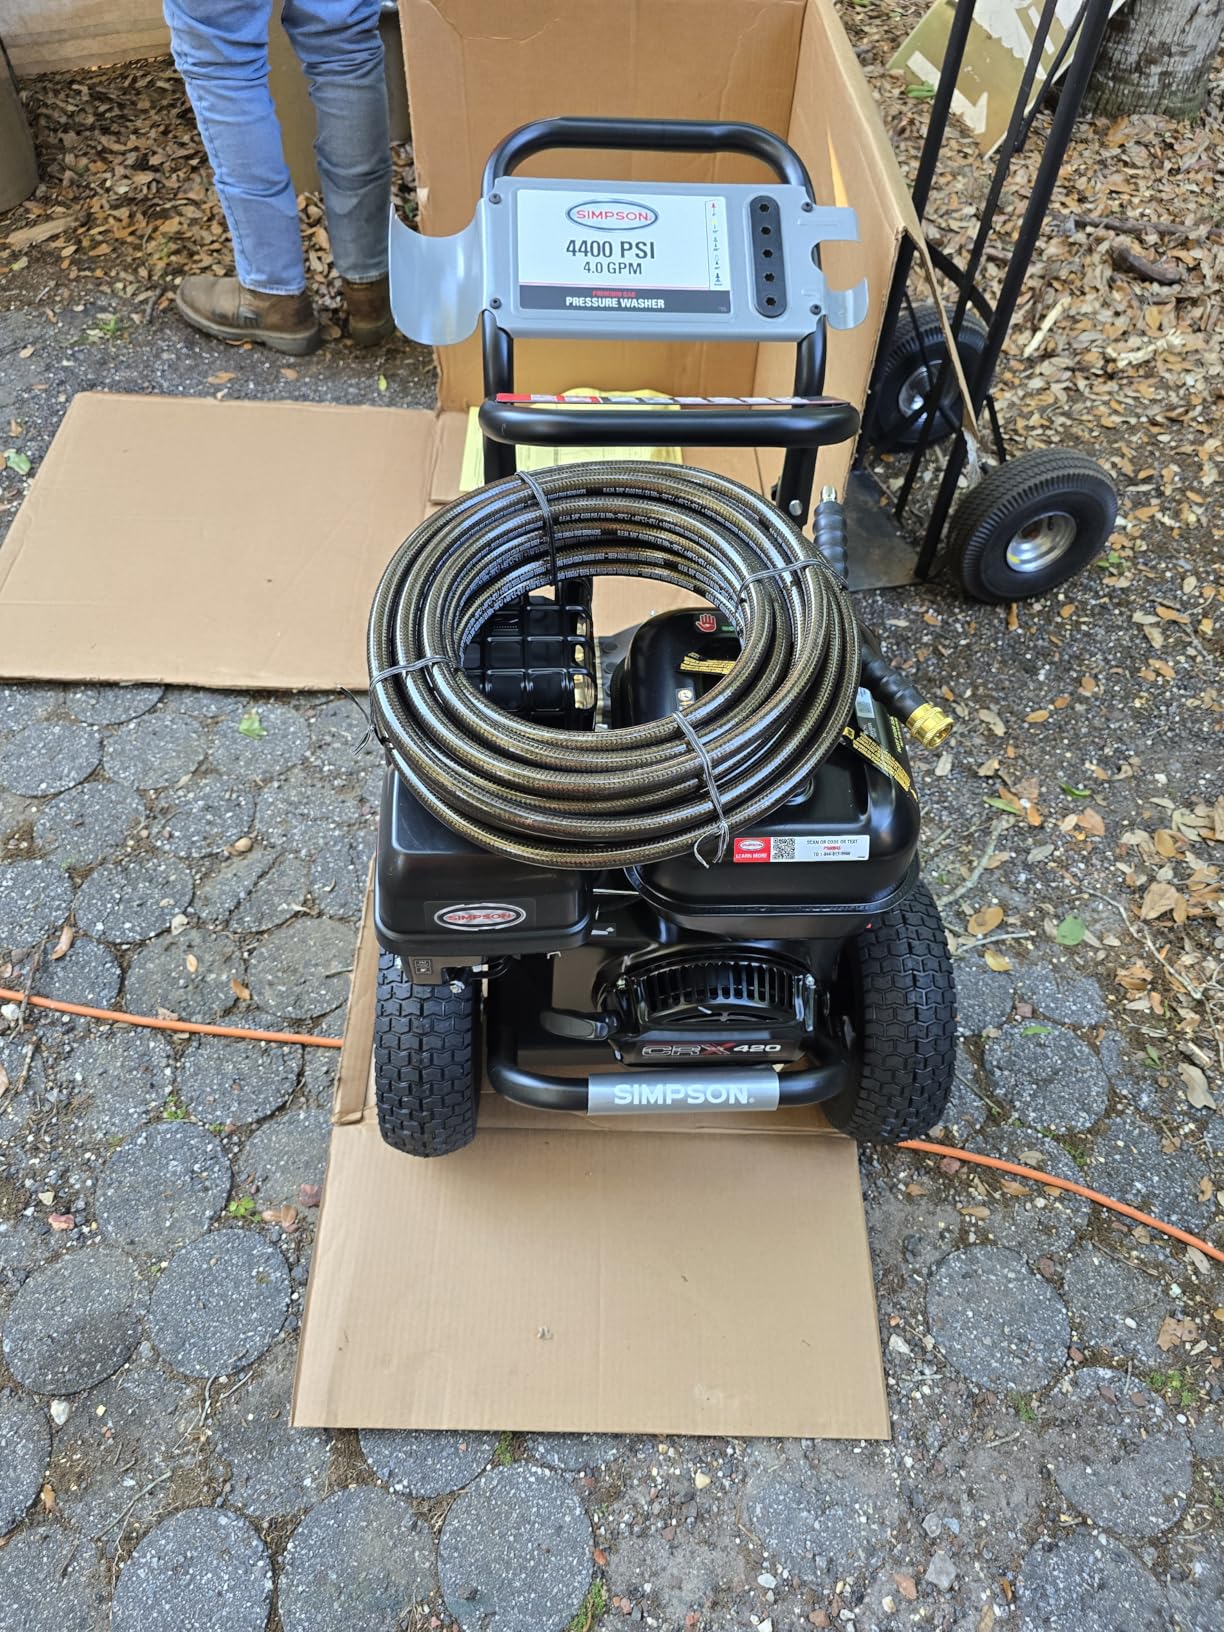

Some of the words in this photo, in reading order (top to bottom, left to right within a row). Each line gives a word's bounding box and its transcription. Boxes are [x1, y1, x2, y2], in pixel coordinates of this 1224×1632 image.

[575, 209, 650, 222] SIMPSON
[566, 239, 613, 258] 4400
[620, 240, 655, 260] PSI
[583, 261, 603, 275] 4.0
[606, 262, 643, 276] GPM
[566, 297, 618, 308] PRESSURE
[620, 298, 665, 309] WASHER
[447, 912, 513, 921] SIMPSON
[733, 1044, 782, 1053] 420
[614, 1083, 749, 1105] SIMPSON
